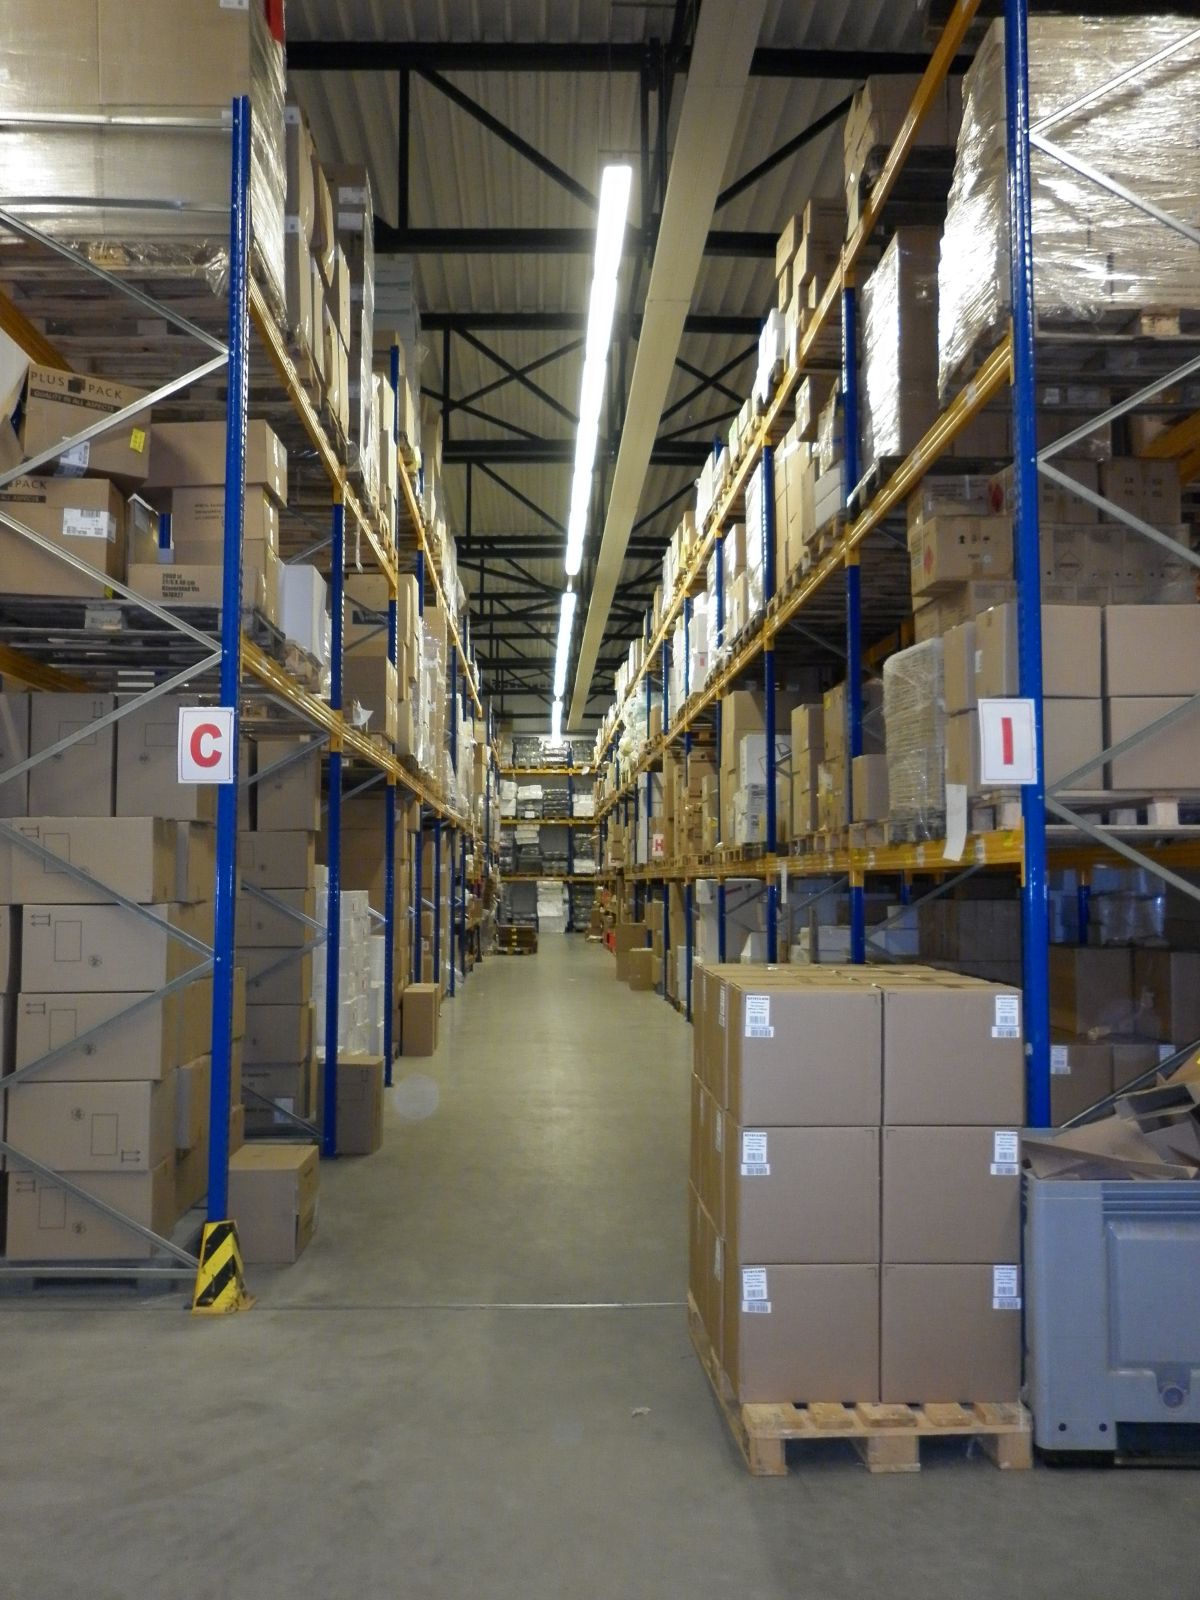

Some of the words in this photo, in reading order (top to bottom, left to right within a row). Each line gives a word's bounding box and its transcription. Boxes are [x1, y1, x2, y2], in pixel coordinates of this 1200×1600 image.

[31, 371, 65, 386] PLUS
[88, 384, 122, 399] PACK
[15, 480, 47, 490] PACK
[190, 723, 222, 768] C
[1001, 717, 1014, 765] I
[655, 839, 664, 851] H
